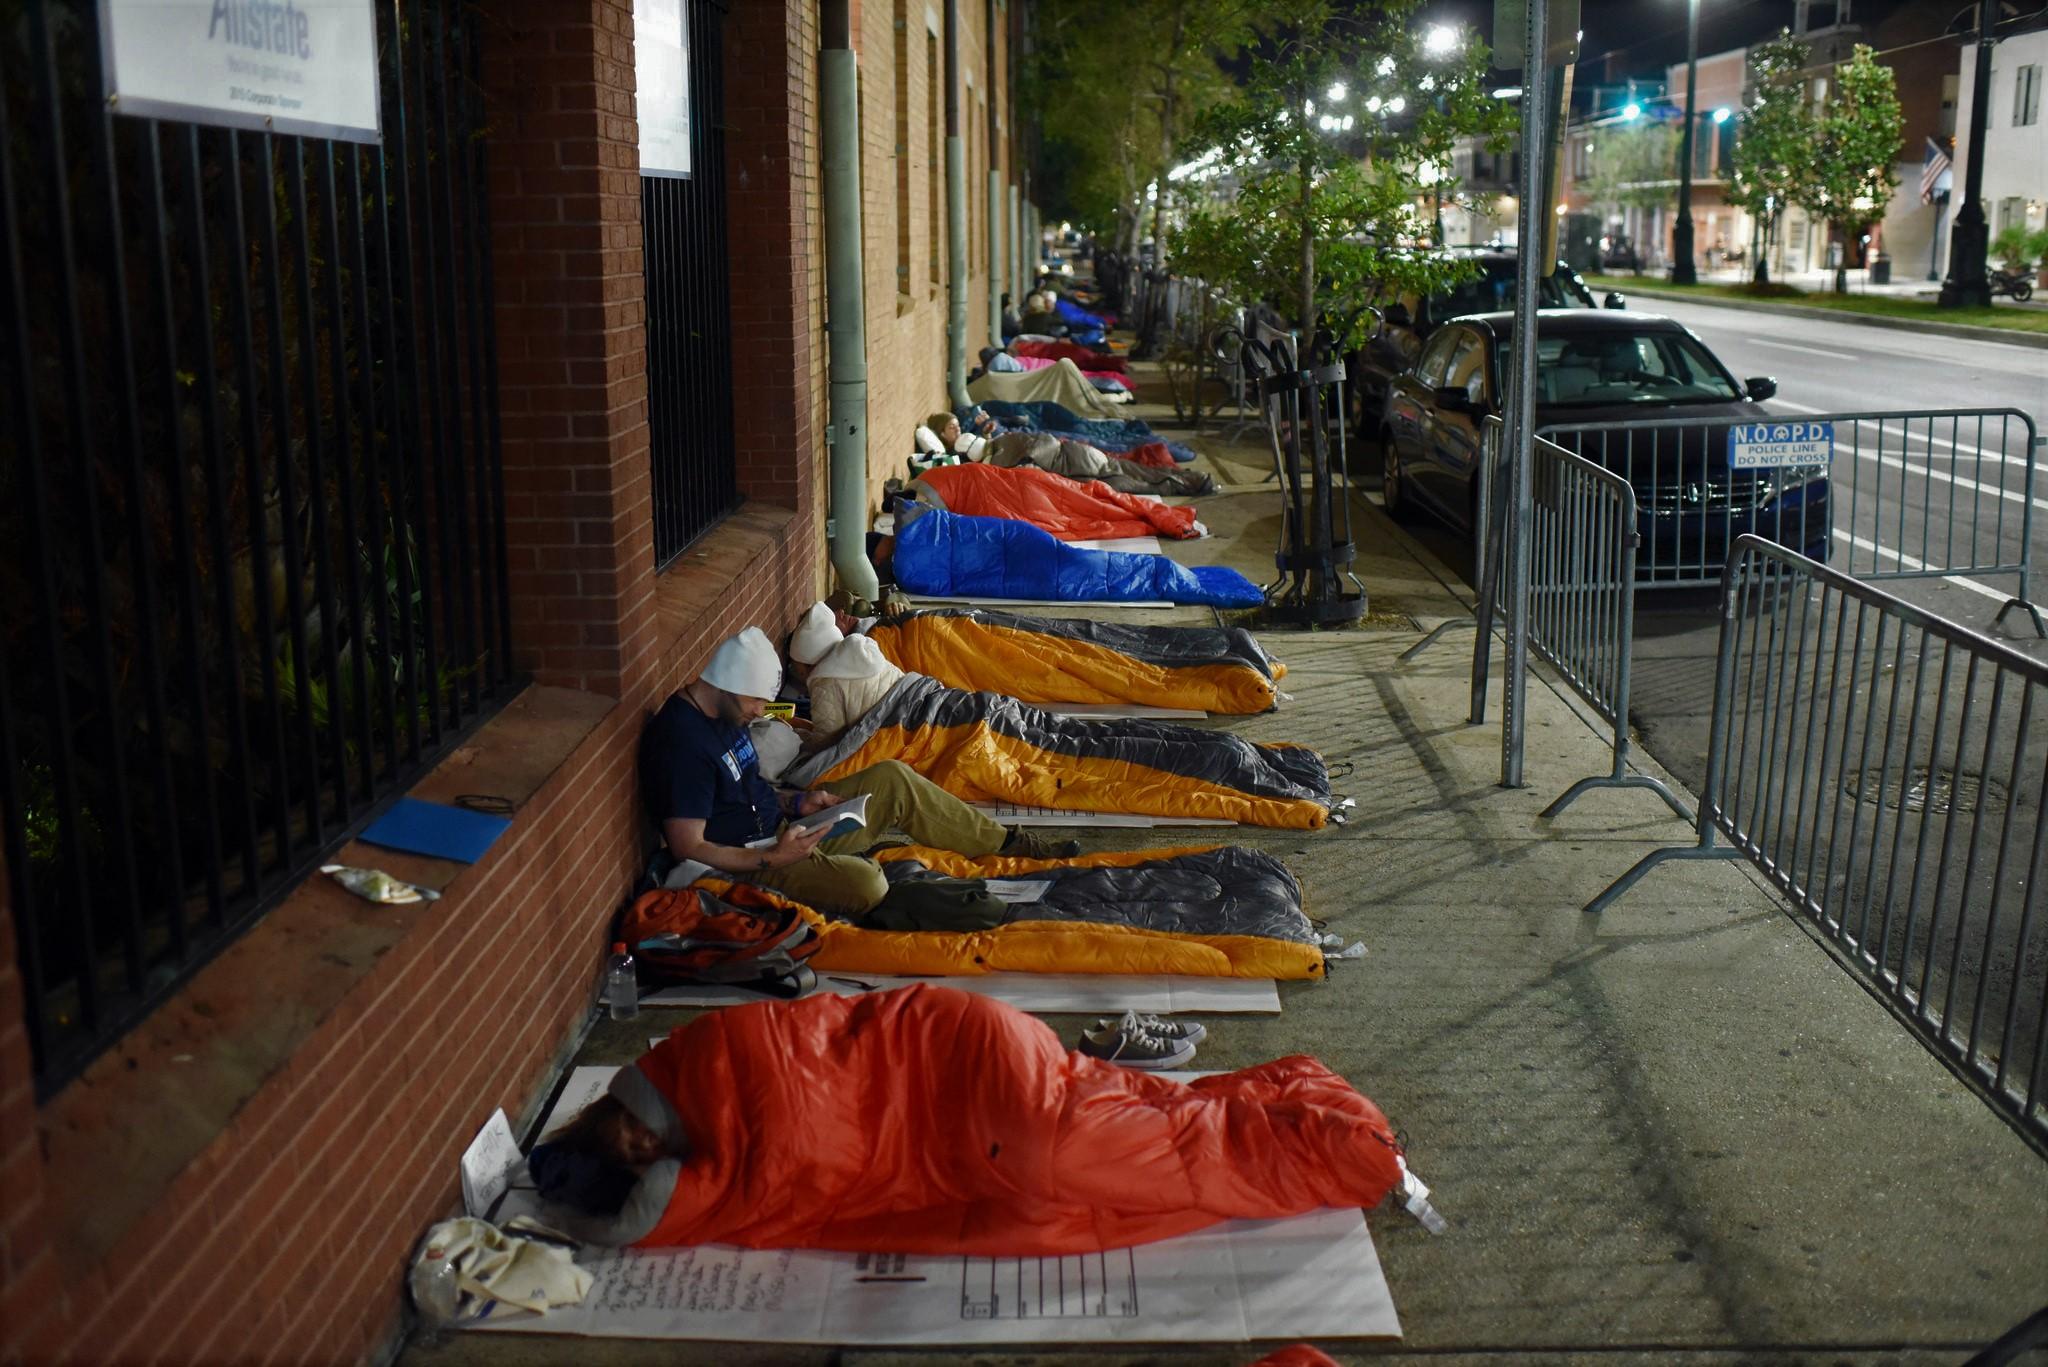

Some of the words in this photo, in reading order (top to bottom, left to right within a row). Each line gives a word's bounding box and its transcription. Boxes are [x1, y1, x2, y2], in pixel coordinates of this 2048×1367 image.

[208, 0, 310, 60] Allstate
[1748, 445, 1787, 454] POLICE
[1792, 444, 1817, 453] LINE
[1738, 456, 1756, 465] DO
[1760, 455, 1784, 464] NOT
[1789, 454, 1826, 463] CROSS
